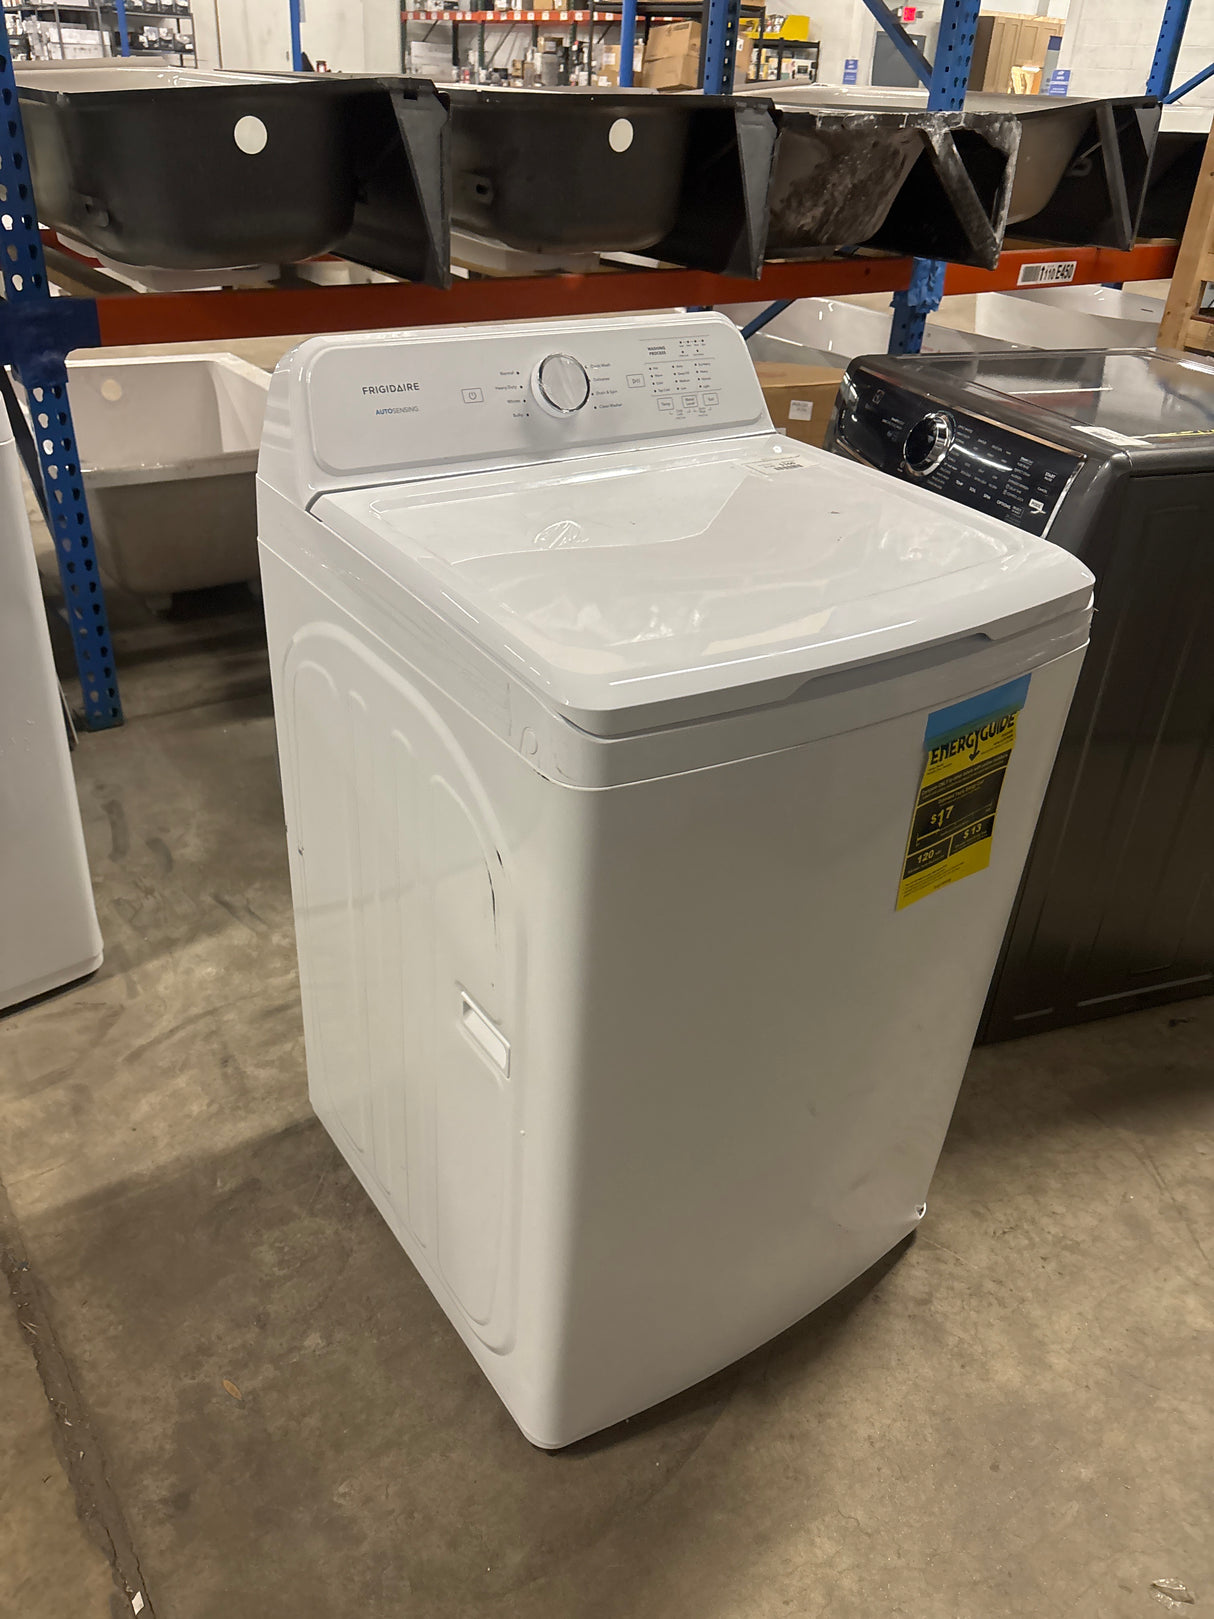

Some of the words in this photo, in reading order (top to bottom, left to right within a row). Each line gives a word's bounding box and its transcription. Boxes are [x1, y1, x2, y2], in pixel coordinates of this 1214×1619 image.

[1055, 263, 1074, 279] E450
[362, 382, 420, 395] FRIGIDAIRE
[375, 405, 420, 416] AUTOSENSING
[930, 712, 1017, 764] ENERGYGUIDE
[917, 849, 935, 864] 120
